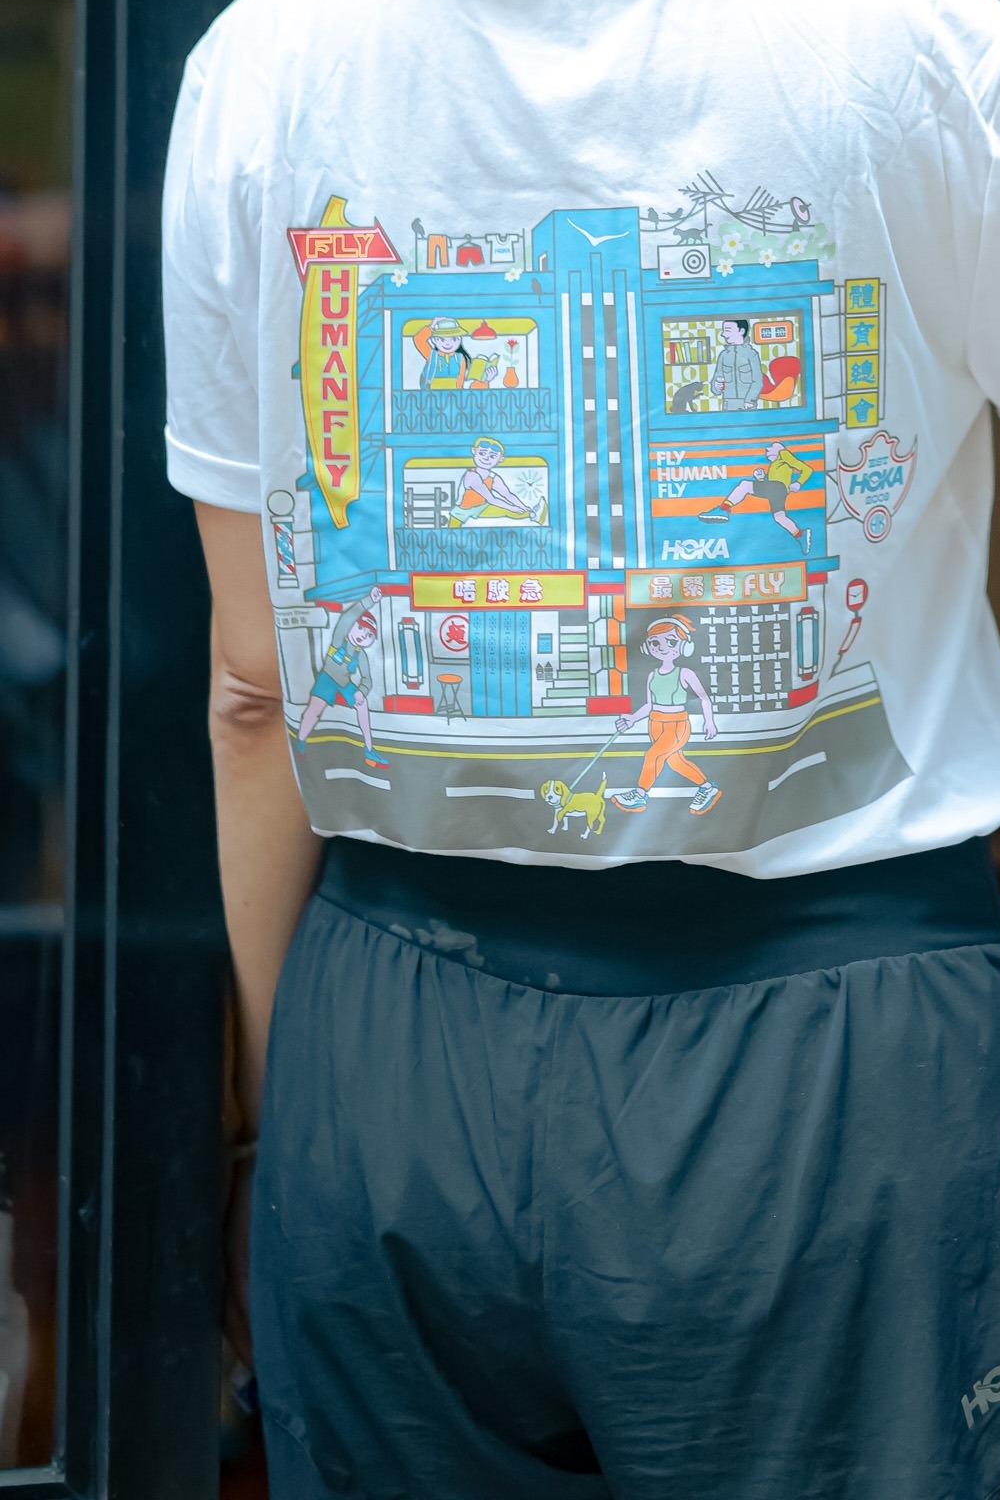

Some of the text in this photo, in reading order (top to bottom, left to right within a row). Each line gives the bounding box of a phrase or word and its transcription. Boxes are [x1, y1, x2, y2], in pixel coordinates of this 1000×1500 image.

[305, 233, 375, 259] FLY
[321, 269, 351, 488] HUMAN FLY
[656, 451, 686, 466] FLY
[657, 465, 727, 482] HUMAN
[849, 466, 903, 495] HOKA
[658, 483, 688, 498] FLY
[661, 538, 730, 560] HOKA
